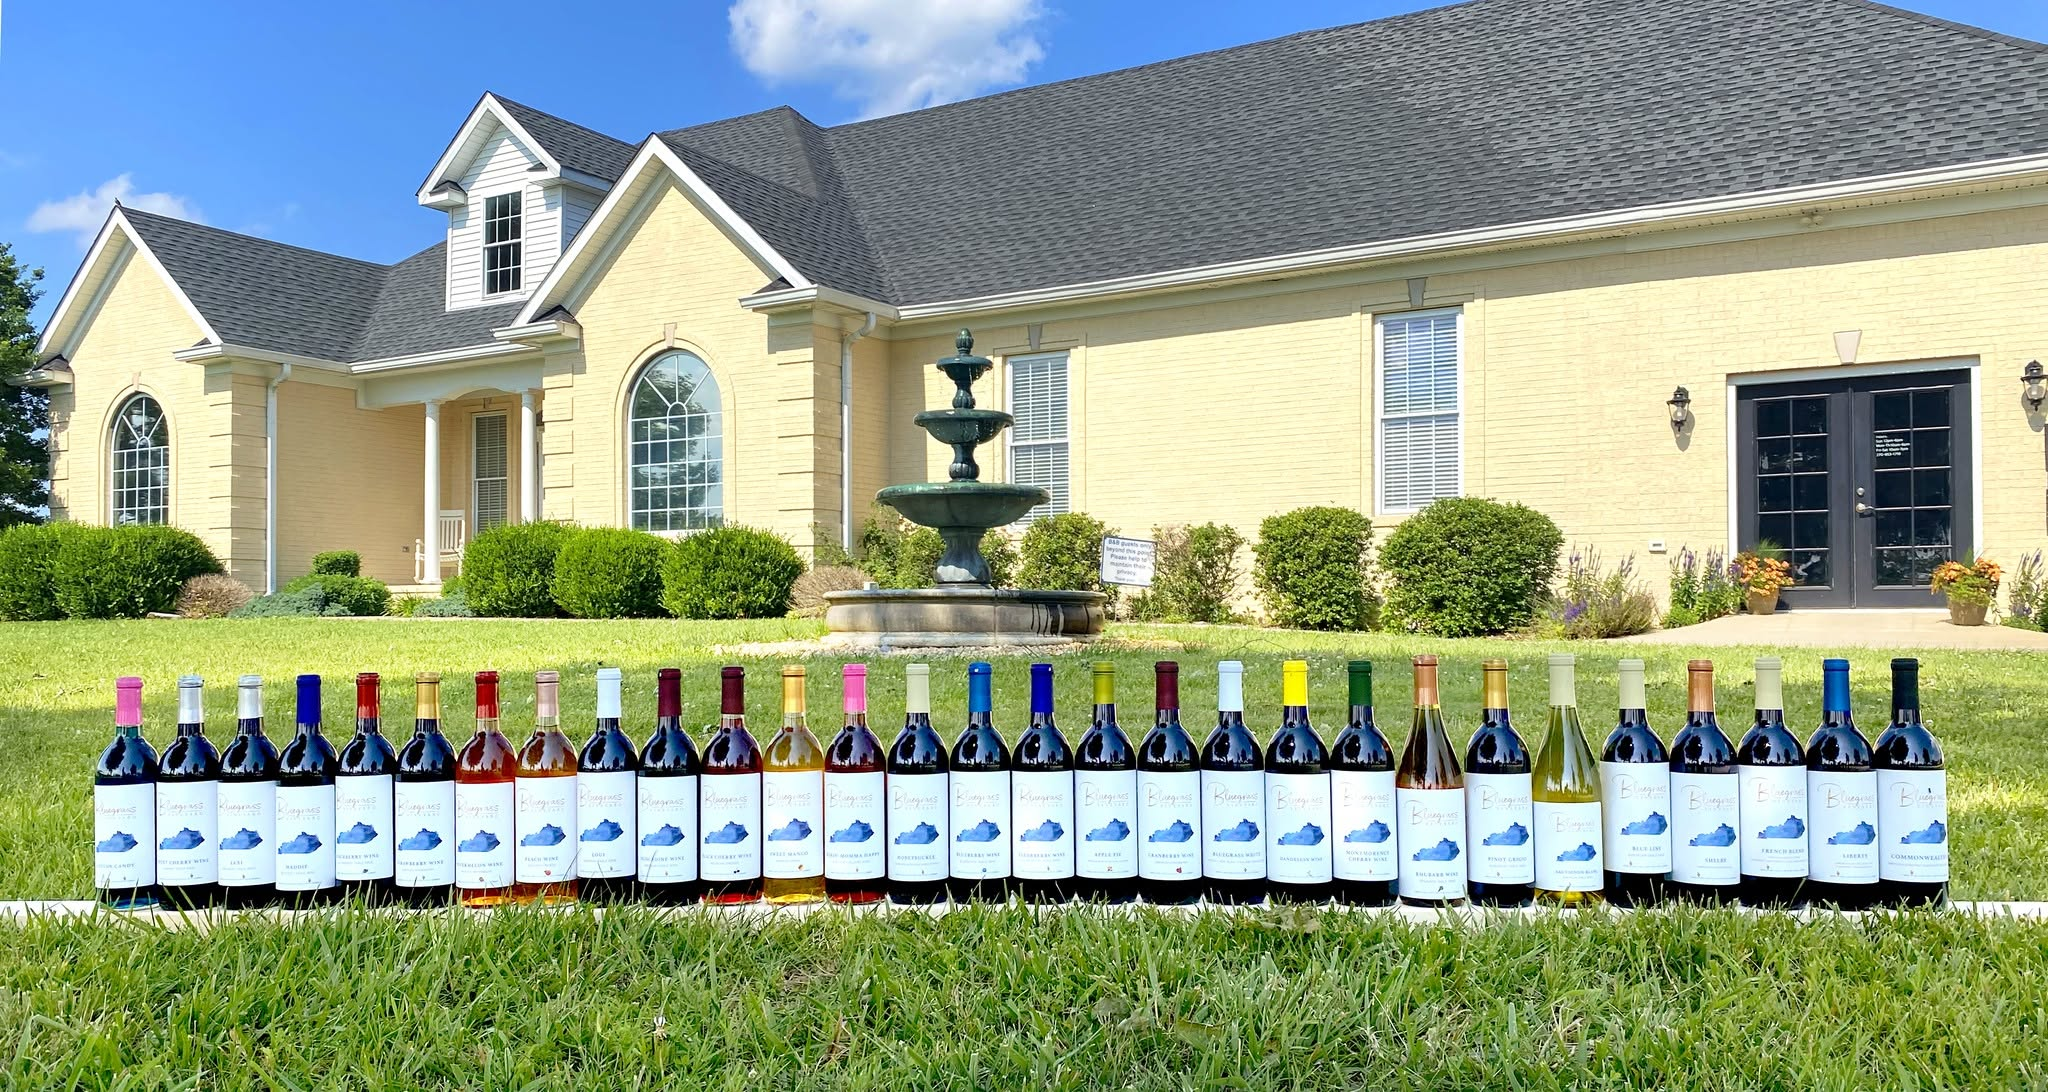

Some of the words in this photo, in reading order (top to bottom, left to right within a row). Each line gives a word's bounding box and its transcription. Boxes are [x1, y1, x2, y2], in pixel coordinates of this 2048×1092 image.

[1080, 782, 1128, 806] Bluegrass
[1142, 782, 1192, 807] Bluegrass
[1207, 781, 1258, 806] Bluegrass
[1474, 784, 1528, 809] Bluegrass
[1612, 773, 1666, 799] Bluegrass
